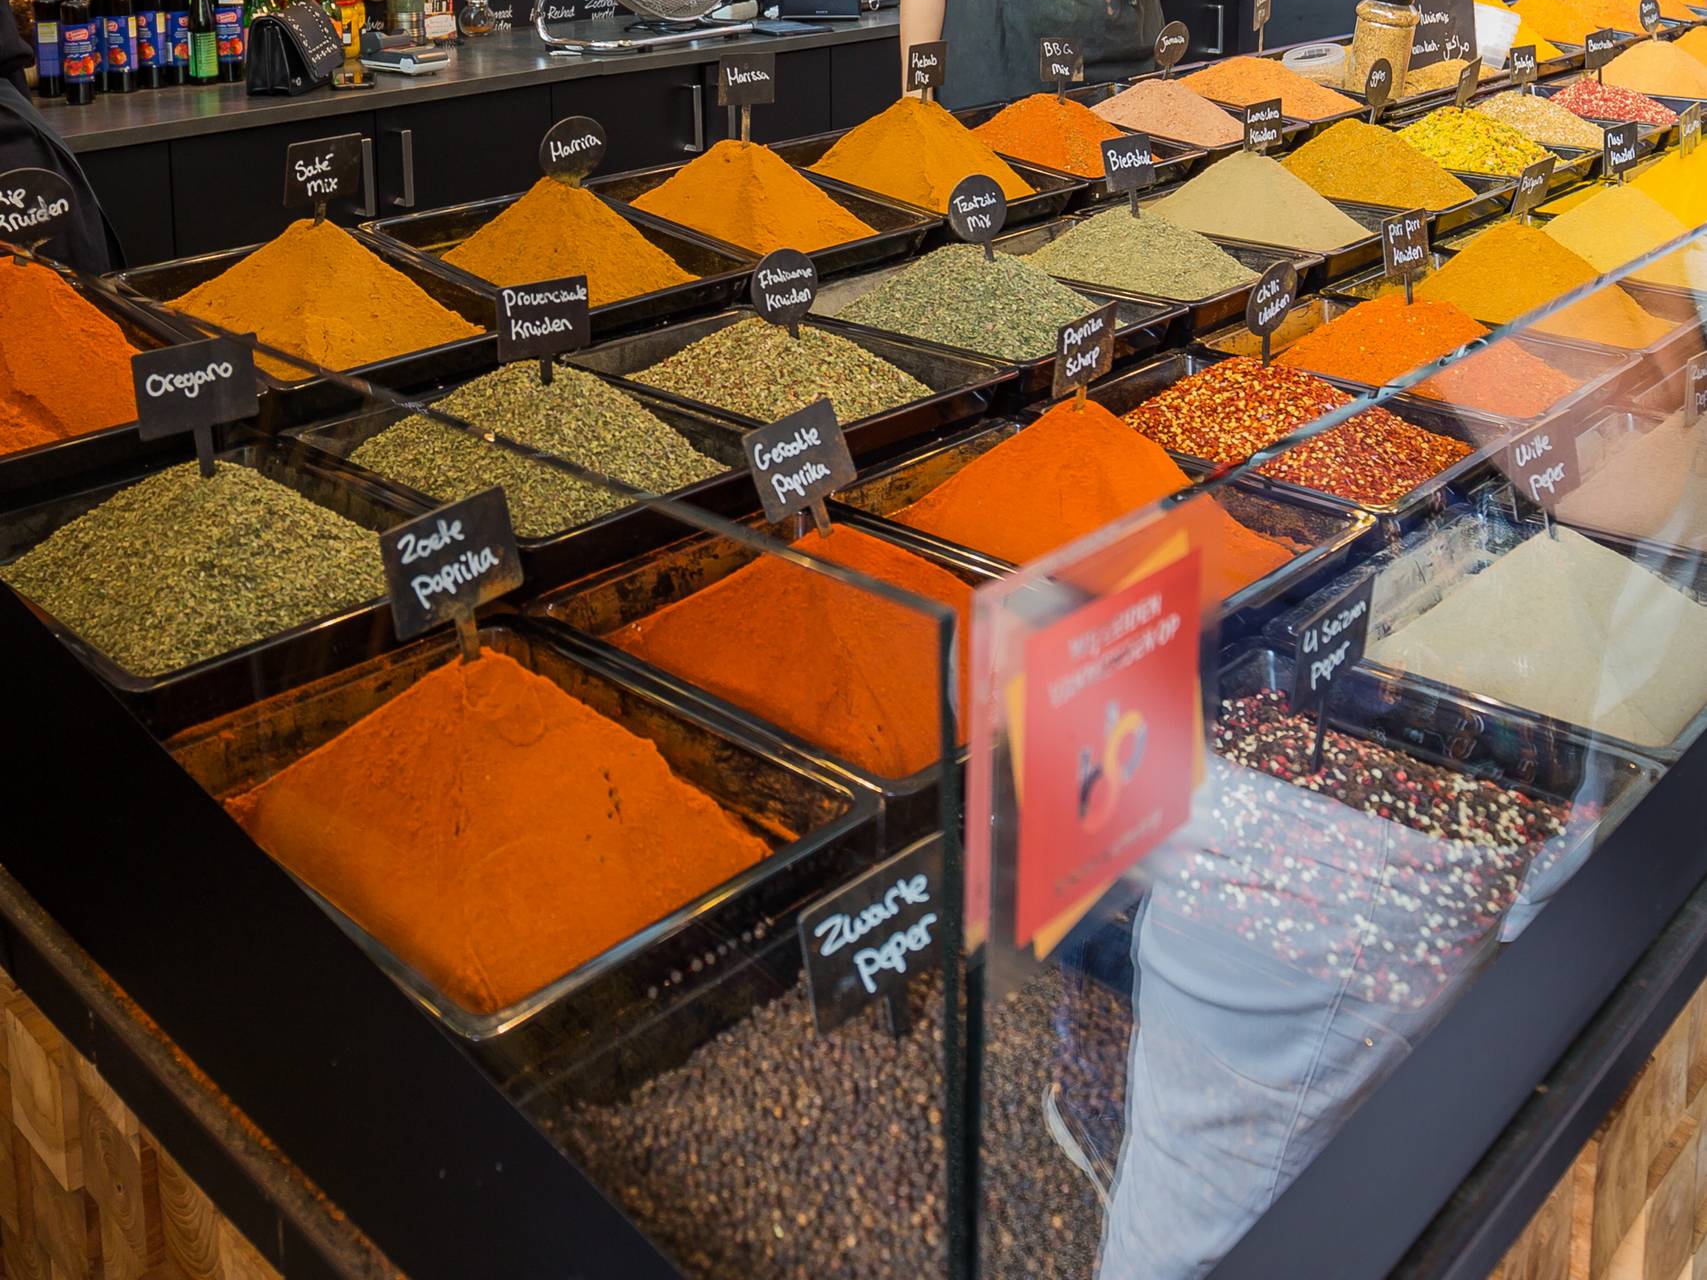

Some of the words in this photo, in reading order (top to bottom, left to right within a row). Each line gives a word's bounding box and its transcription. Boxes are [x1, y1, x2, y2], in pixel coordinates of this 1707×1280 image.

[911, 52, 938, 68] Kebab
[549, 134, 602, 162] Harrira
[294, 153, 335, 182] Saté
[145, 361, 233, 399] Oregano
[814, 873, 930, 957] Zwarte
